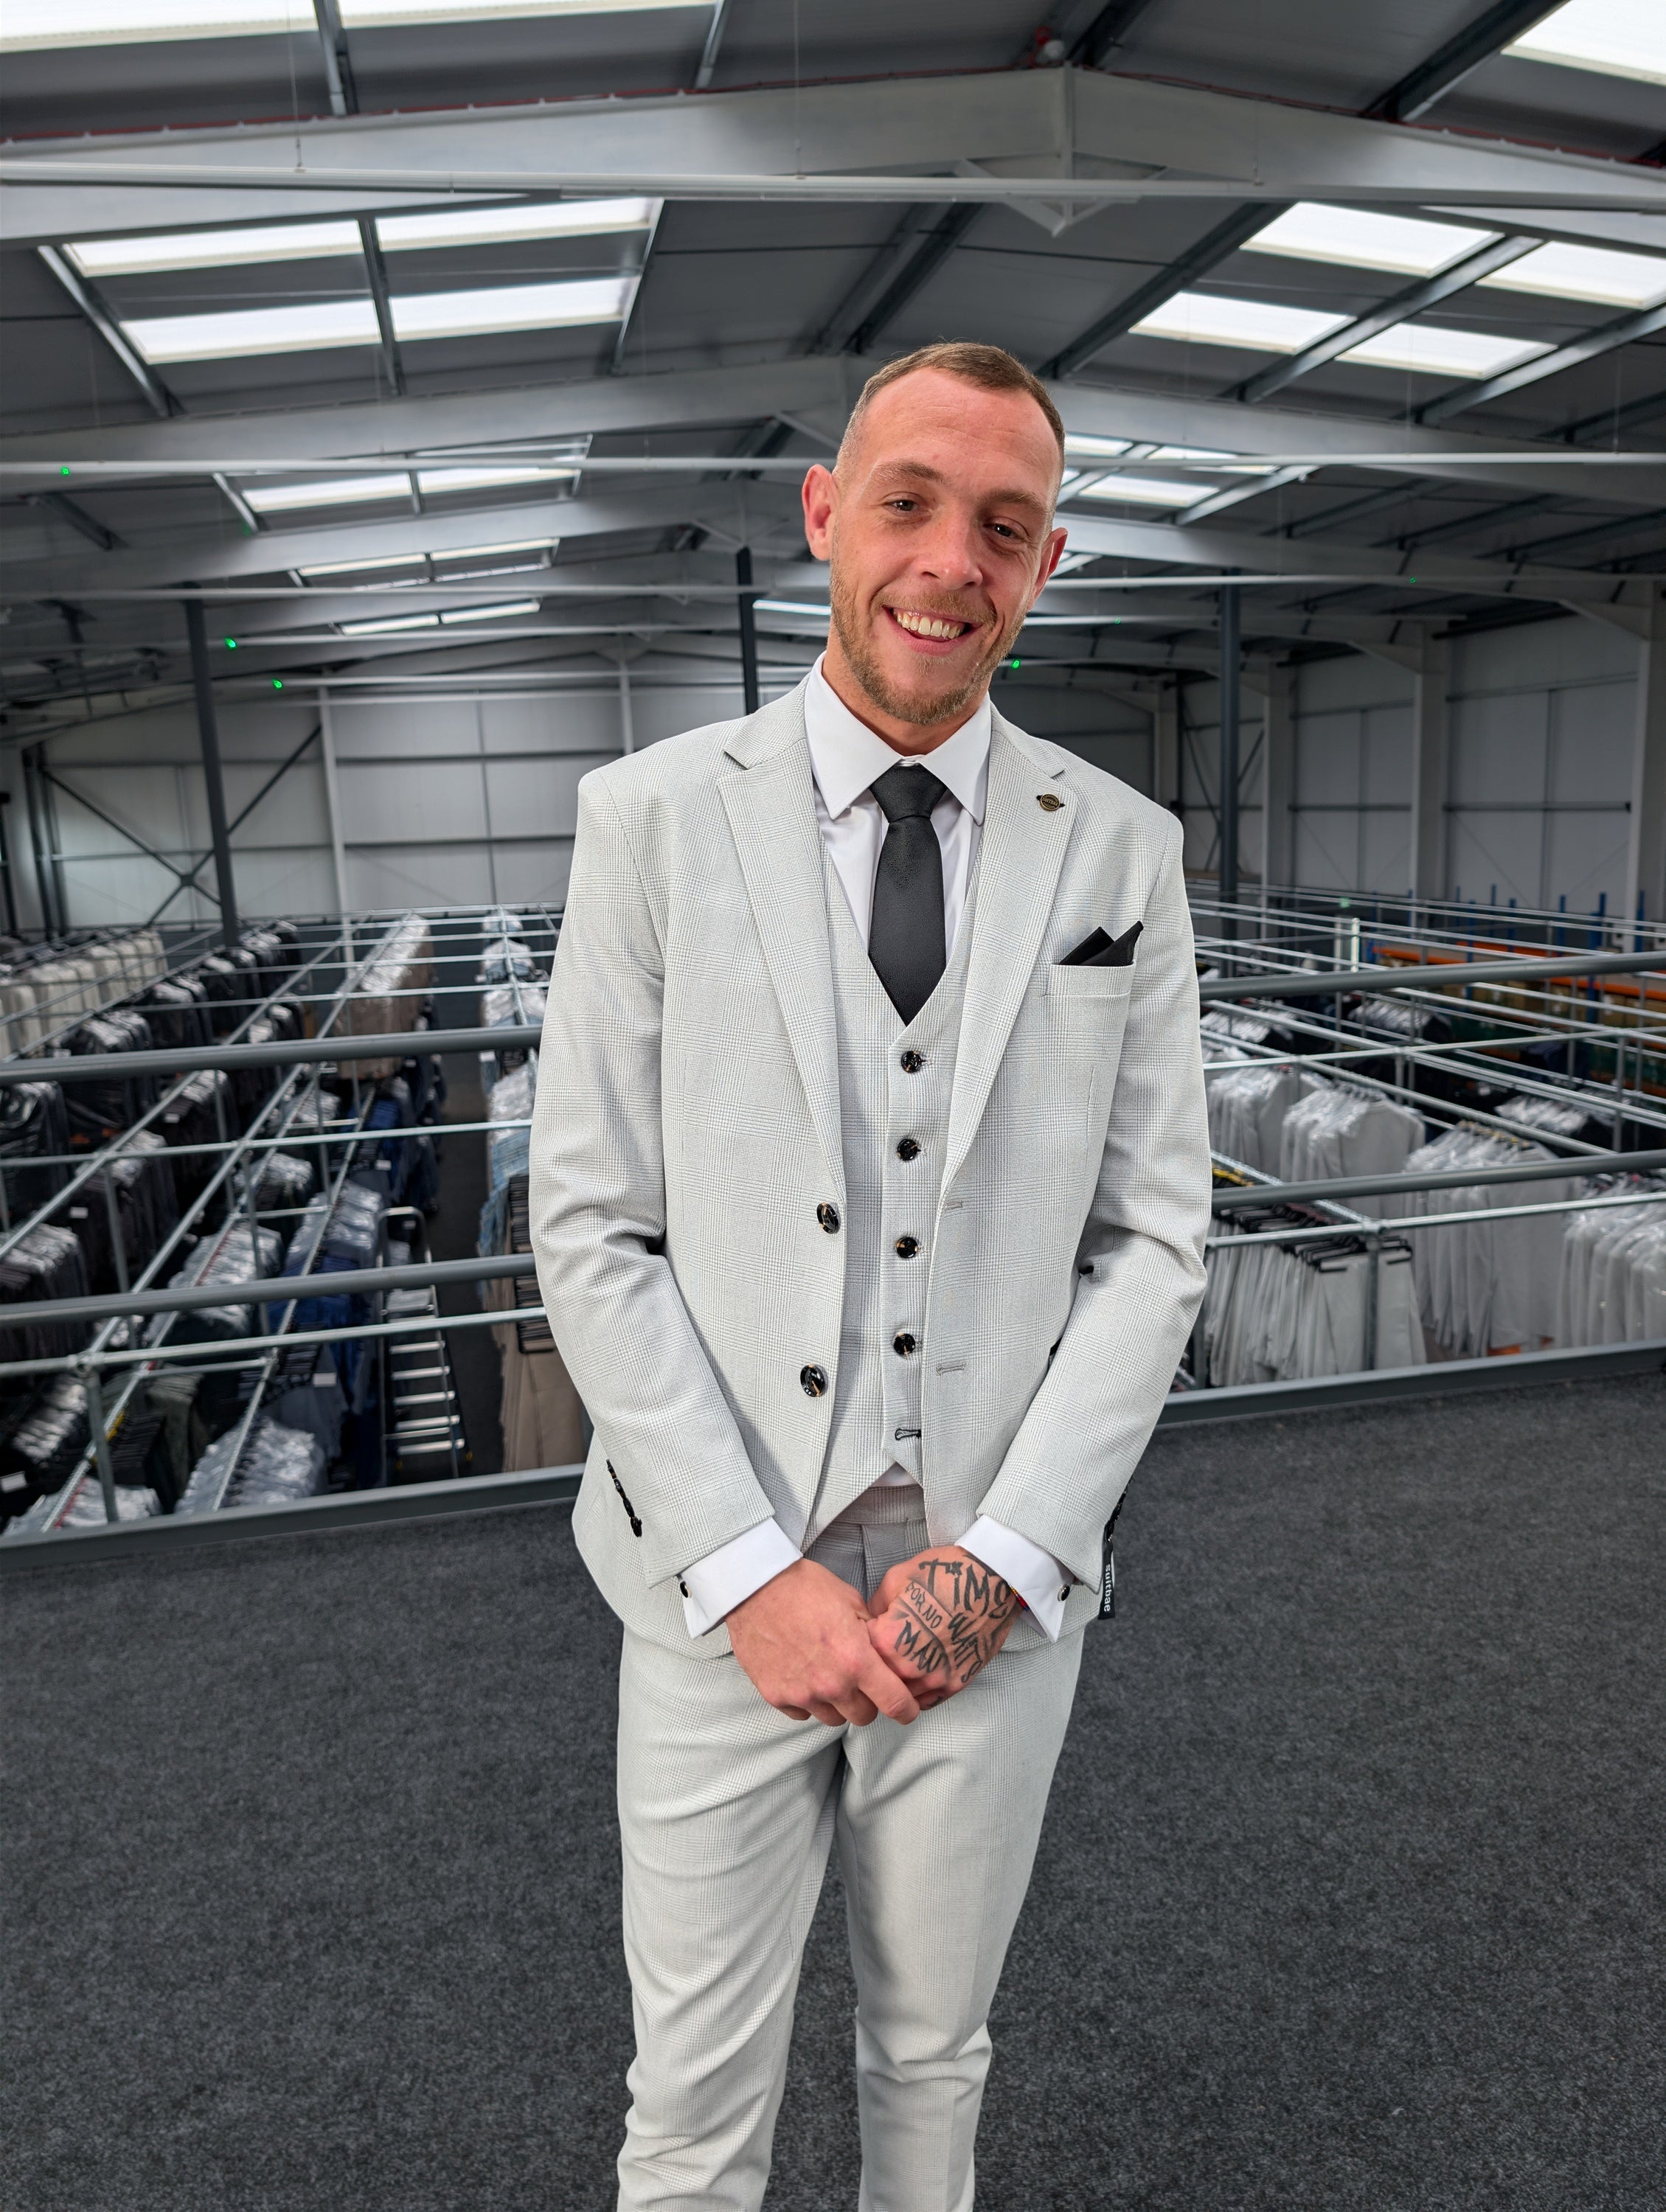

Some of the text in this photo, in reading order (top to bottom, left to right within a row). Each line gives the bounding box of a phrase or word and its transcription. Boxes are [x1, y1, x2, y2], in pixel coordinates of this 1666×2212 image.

[905, 1581, 943, 1629] FOR NO
[1103, 1563, 1112, 1613] suitbae
[895, 1620, 946, 1673] MAN
